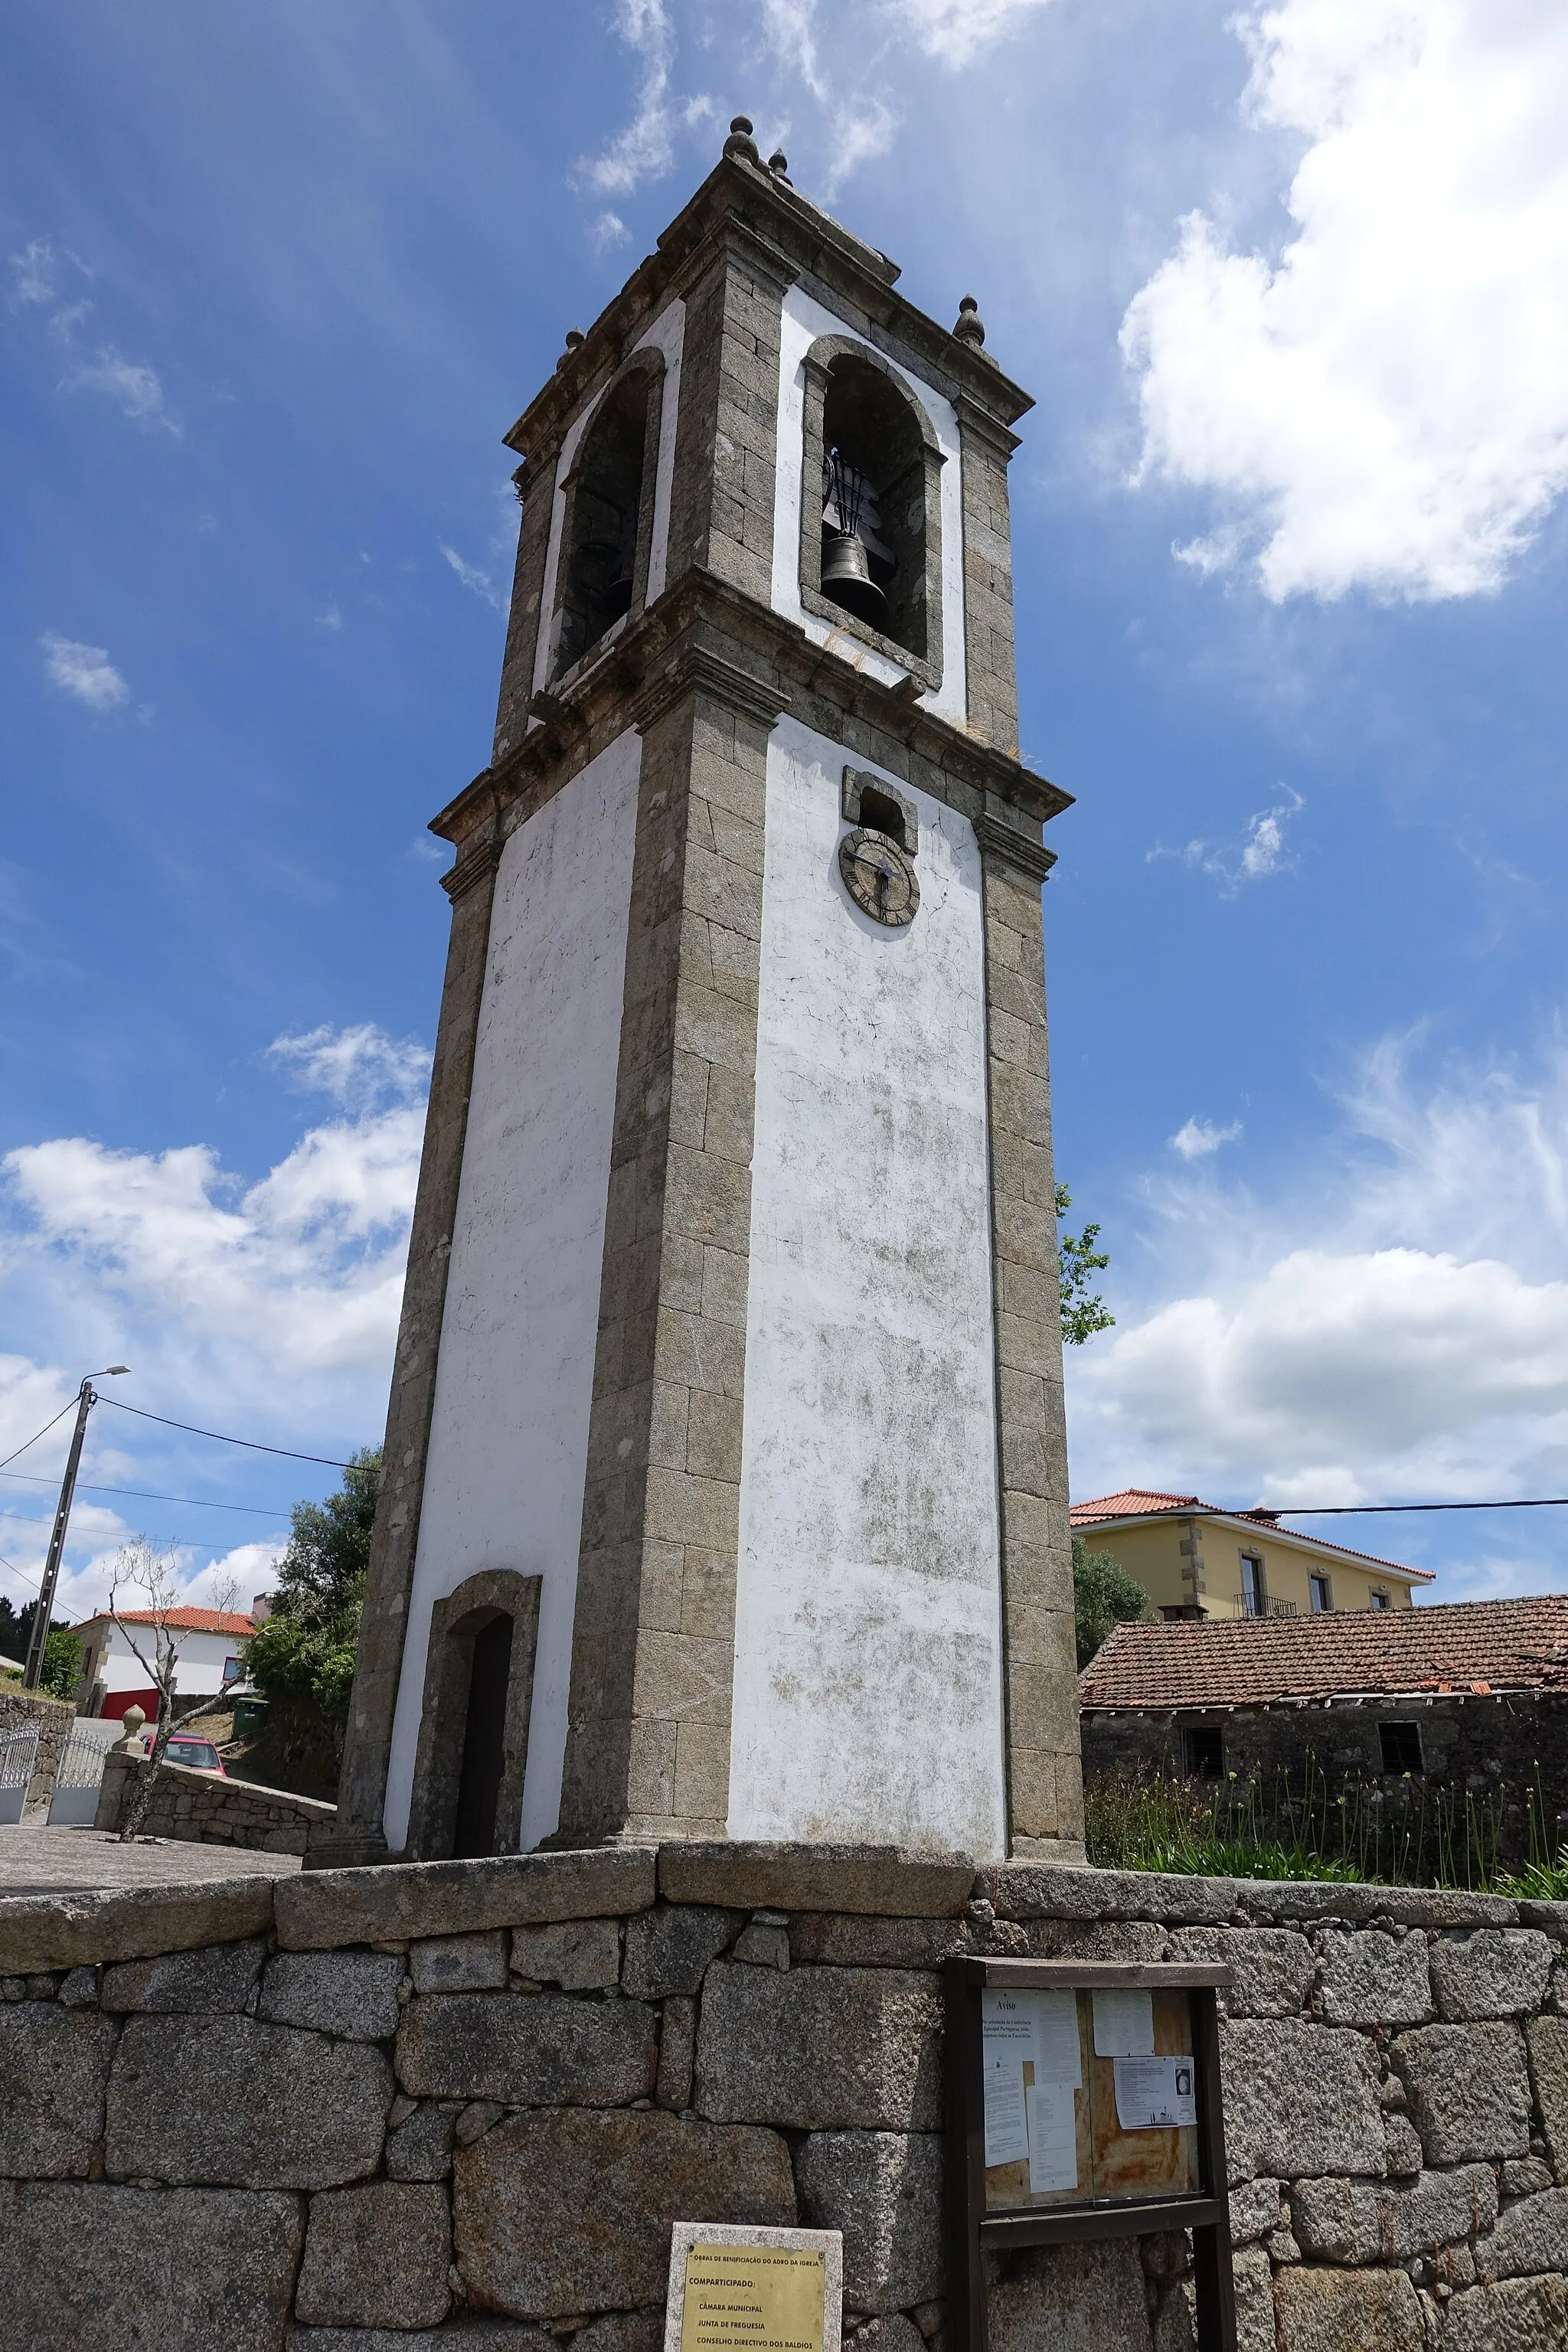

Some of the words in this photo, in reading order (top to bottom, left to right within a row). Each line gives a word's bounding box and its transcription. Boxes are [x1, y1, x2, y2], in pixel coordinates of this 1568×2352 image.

[877, 831, 889, 847] XII
[895, 912, 904, 924] V
[998, 2001, 1016, 2010] Aviso
[722, 2256, 761, 2265] BENIFICIAÇÃO
[689, 2277, 756, 2288] COMPARTICIPADO:
[699, 2301, 726, 2311] CÂMARA
[727, 2305, 763, 2313] MUNICIPAL
[730, 2321, 766, 2330] FREGUESIA
[697, 2337, 733, 2345] CONSELHO
[785, 2341, 813, 2350] BALDIOS
